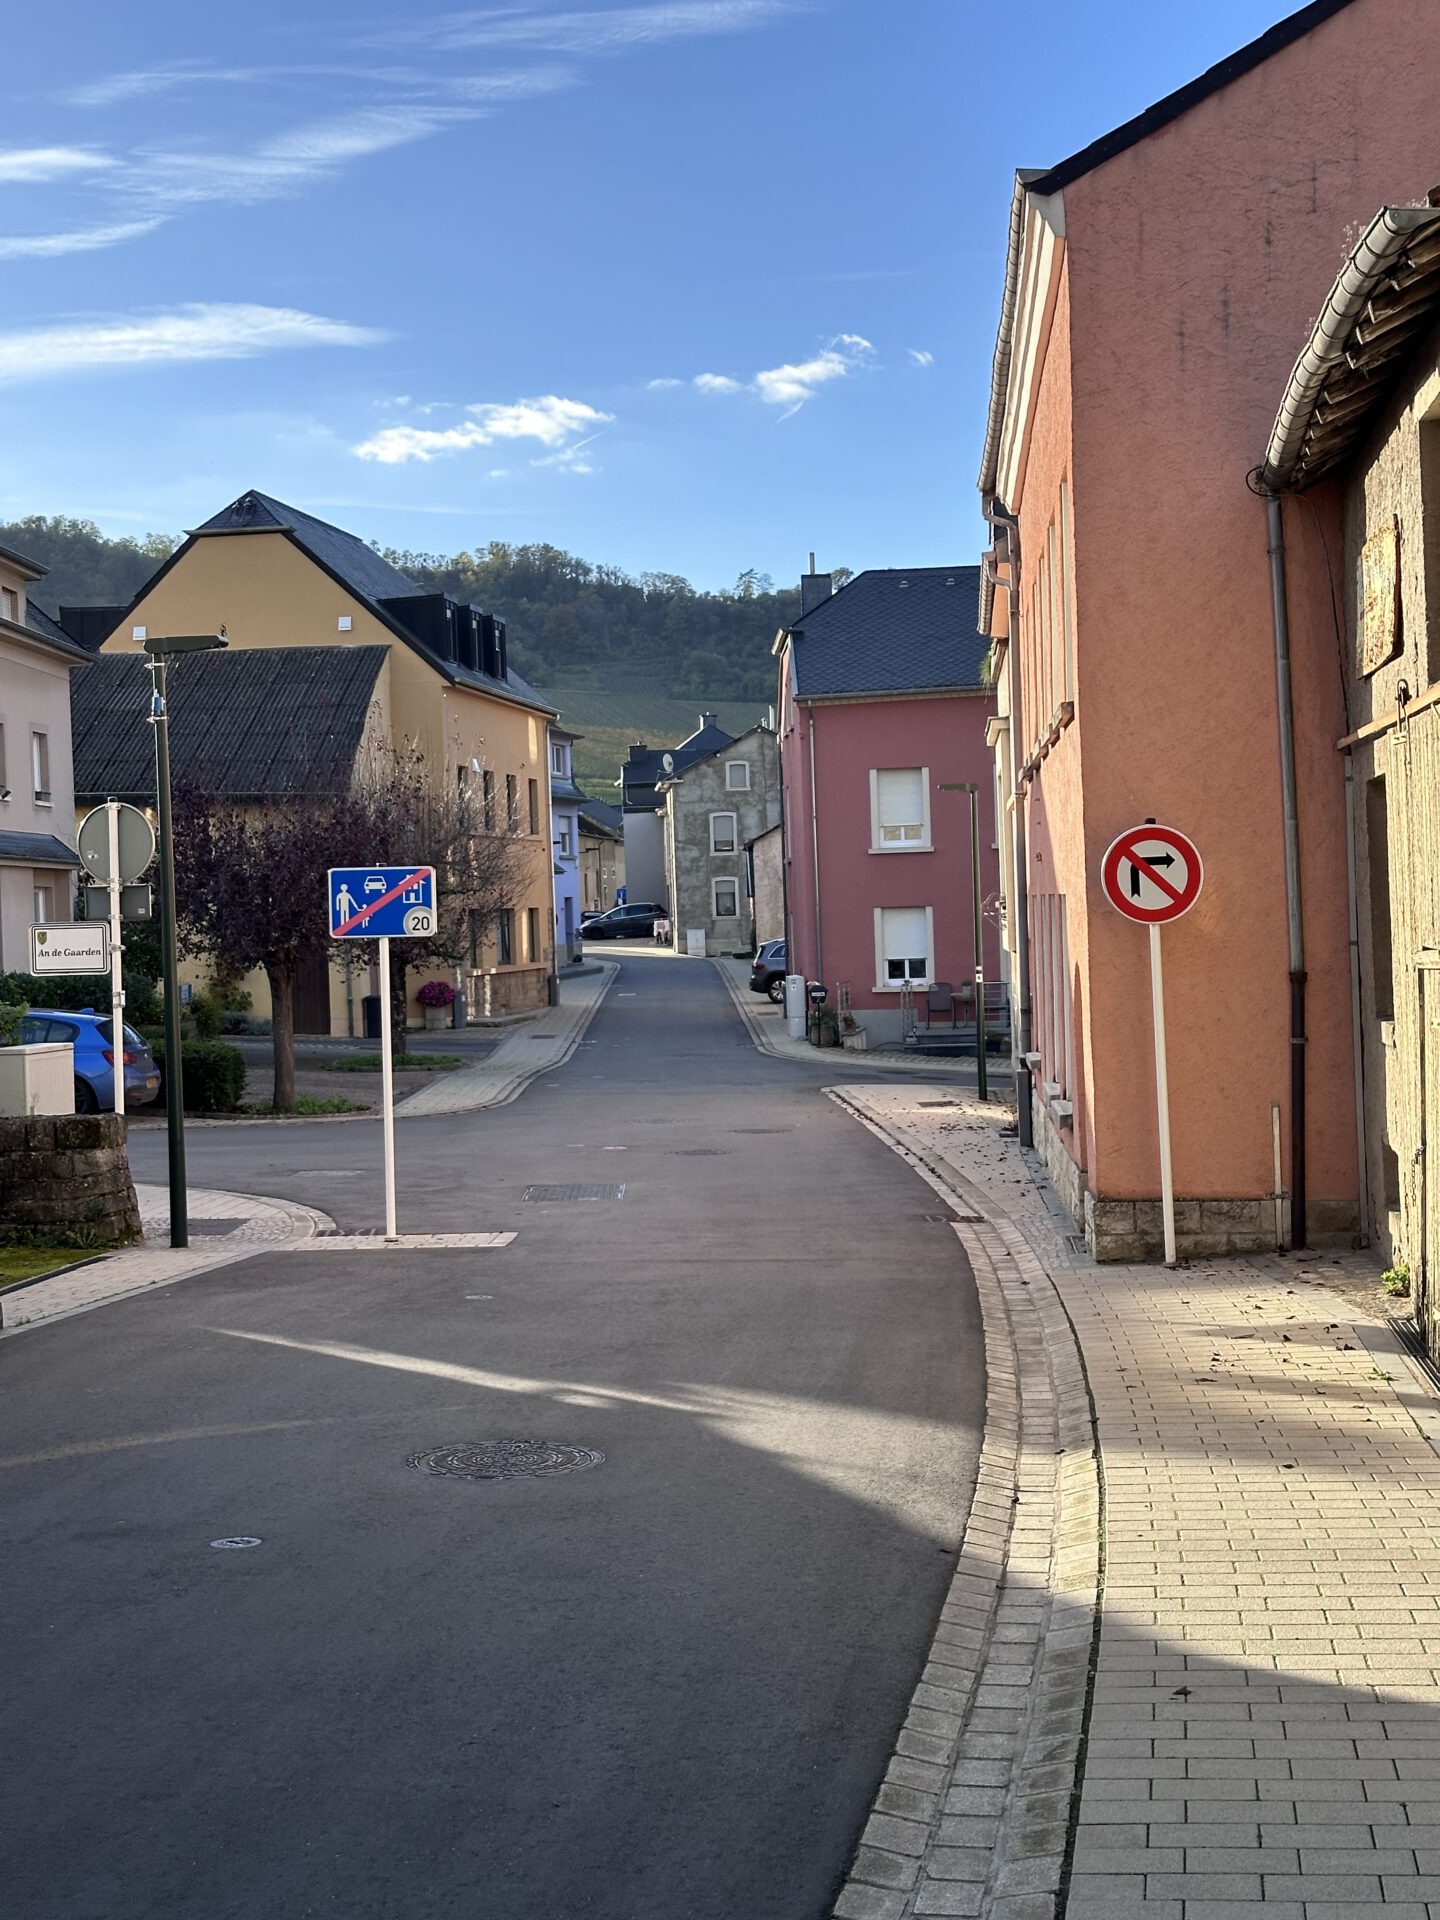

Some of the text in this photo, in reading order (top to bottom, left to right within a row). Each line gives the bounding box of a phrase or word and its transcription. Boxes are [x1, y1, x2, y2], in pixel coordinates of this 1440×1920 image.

[412, 916, 430, 931] 20
[38, 948, 101, 957] An de Gaarden
